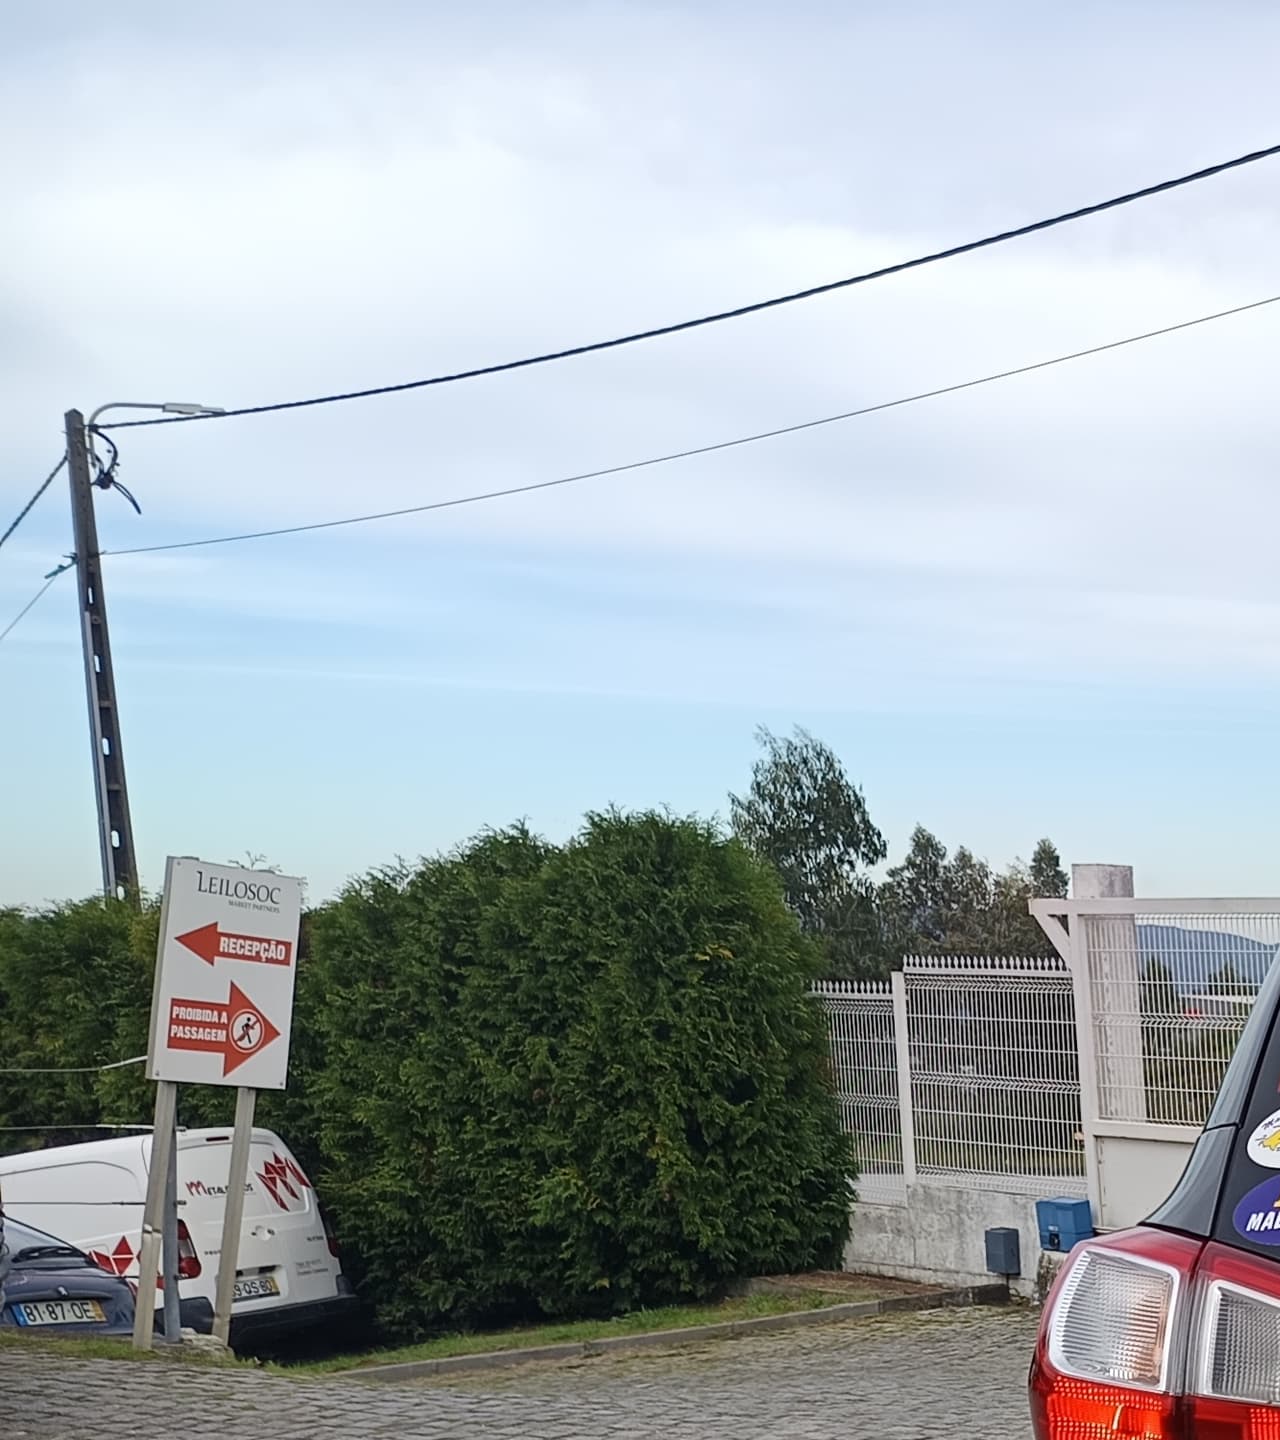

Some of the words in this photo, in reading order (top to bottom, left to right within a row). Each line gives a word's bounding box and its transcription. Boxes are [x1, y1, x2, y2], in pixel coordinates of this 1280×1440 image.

[196, 870, 281, 905] LEILOSOC
[220, 936, 286, 962] RECEPÇÃO
[172, 1006, 219, 1024] PROIBIDA
[220, 1010, 228, 1025] A
[170, 1025, 227, 1042] PASSAGEM
